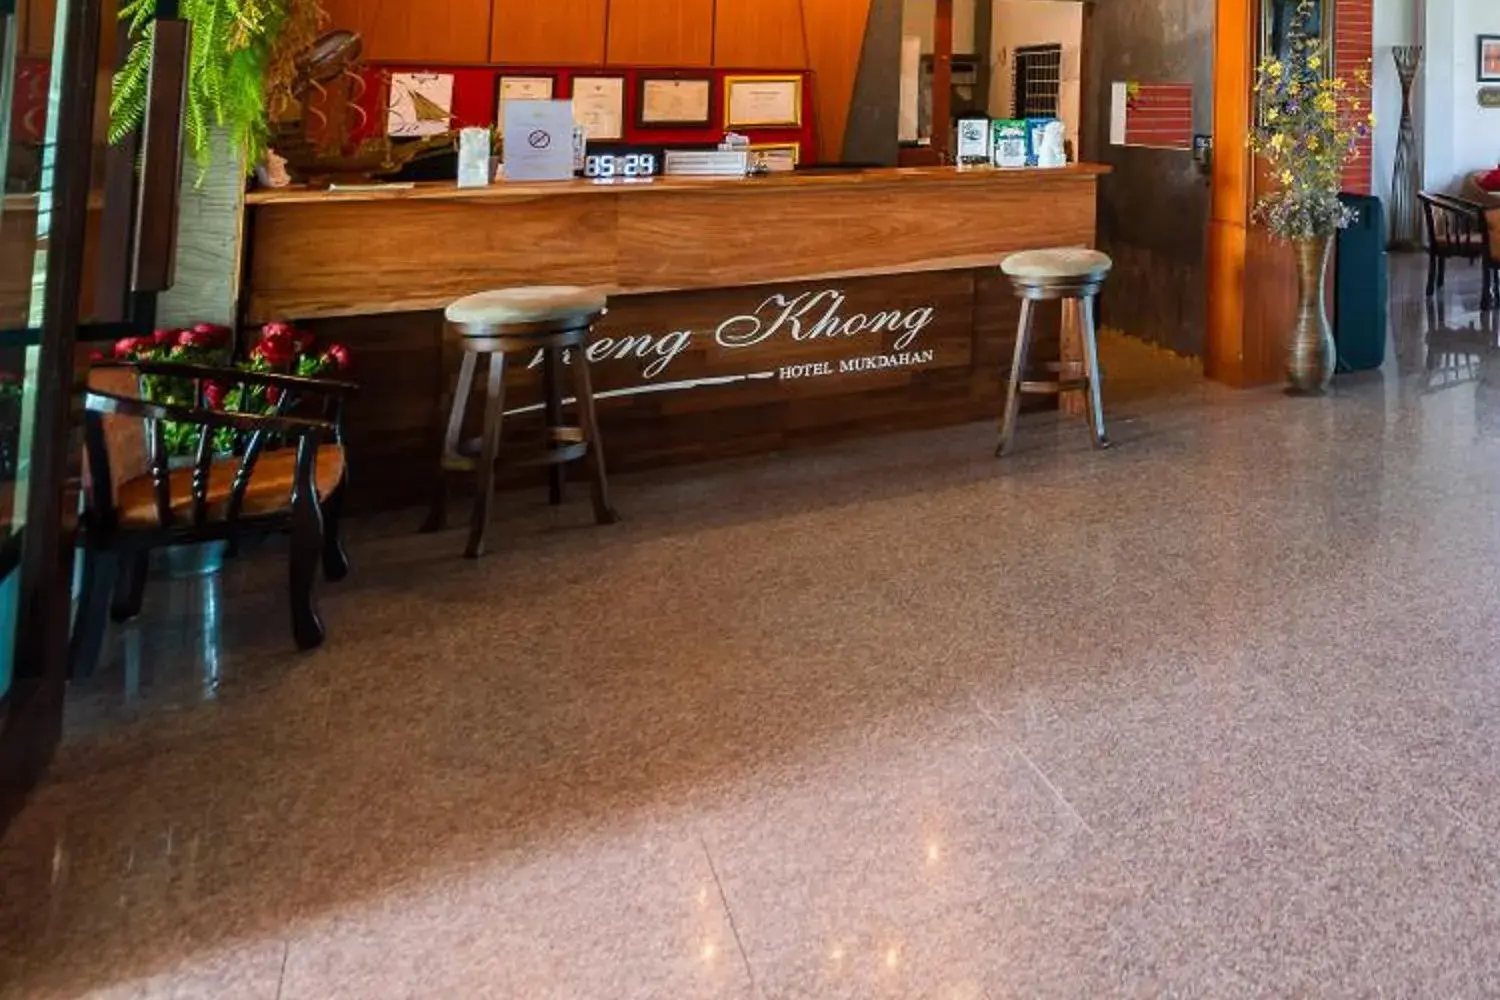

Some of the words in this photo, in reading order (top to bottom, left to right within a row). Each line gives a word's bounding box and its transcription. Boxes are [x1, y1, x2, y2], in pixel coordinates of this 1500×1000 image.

[715, 288, 935, 350] Khong
[779, 361, 834, 380] HOTEL
[839, 349, 934, 373] MUKDAHAN
